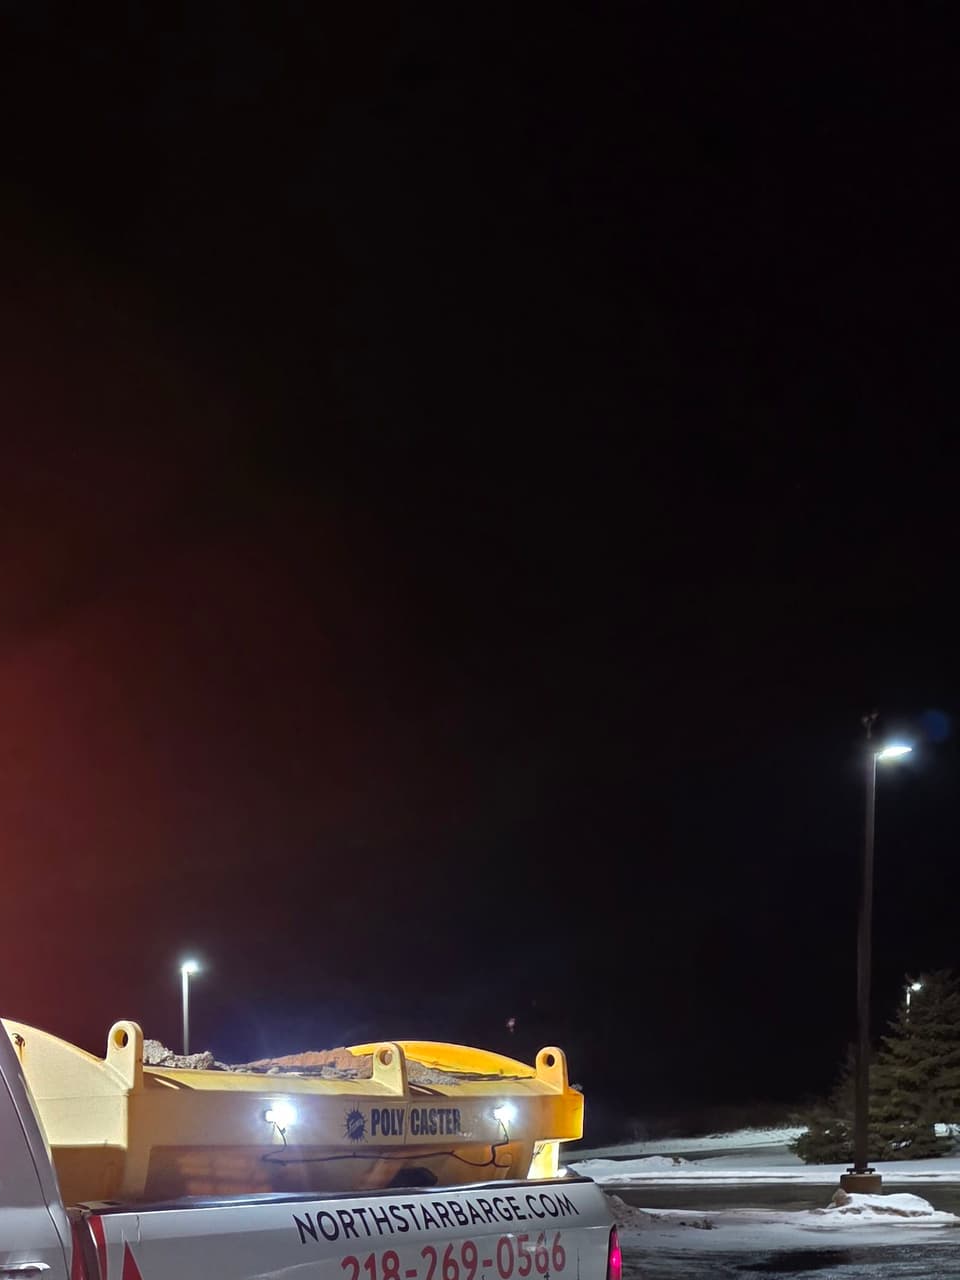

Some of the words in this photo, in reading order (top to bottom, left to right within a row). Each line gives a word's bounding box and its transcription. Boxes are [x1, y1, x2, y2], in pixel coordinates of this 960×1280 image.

[370, 1108, 405, 1136] POLY
[410, 1107, 461, 1136] CASTER
[292, 1192, 580, 1244] NORTHSTARBARGE.COM
